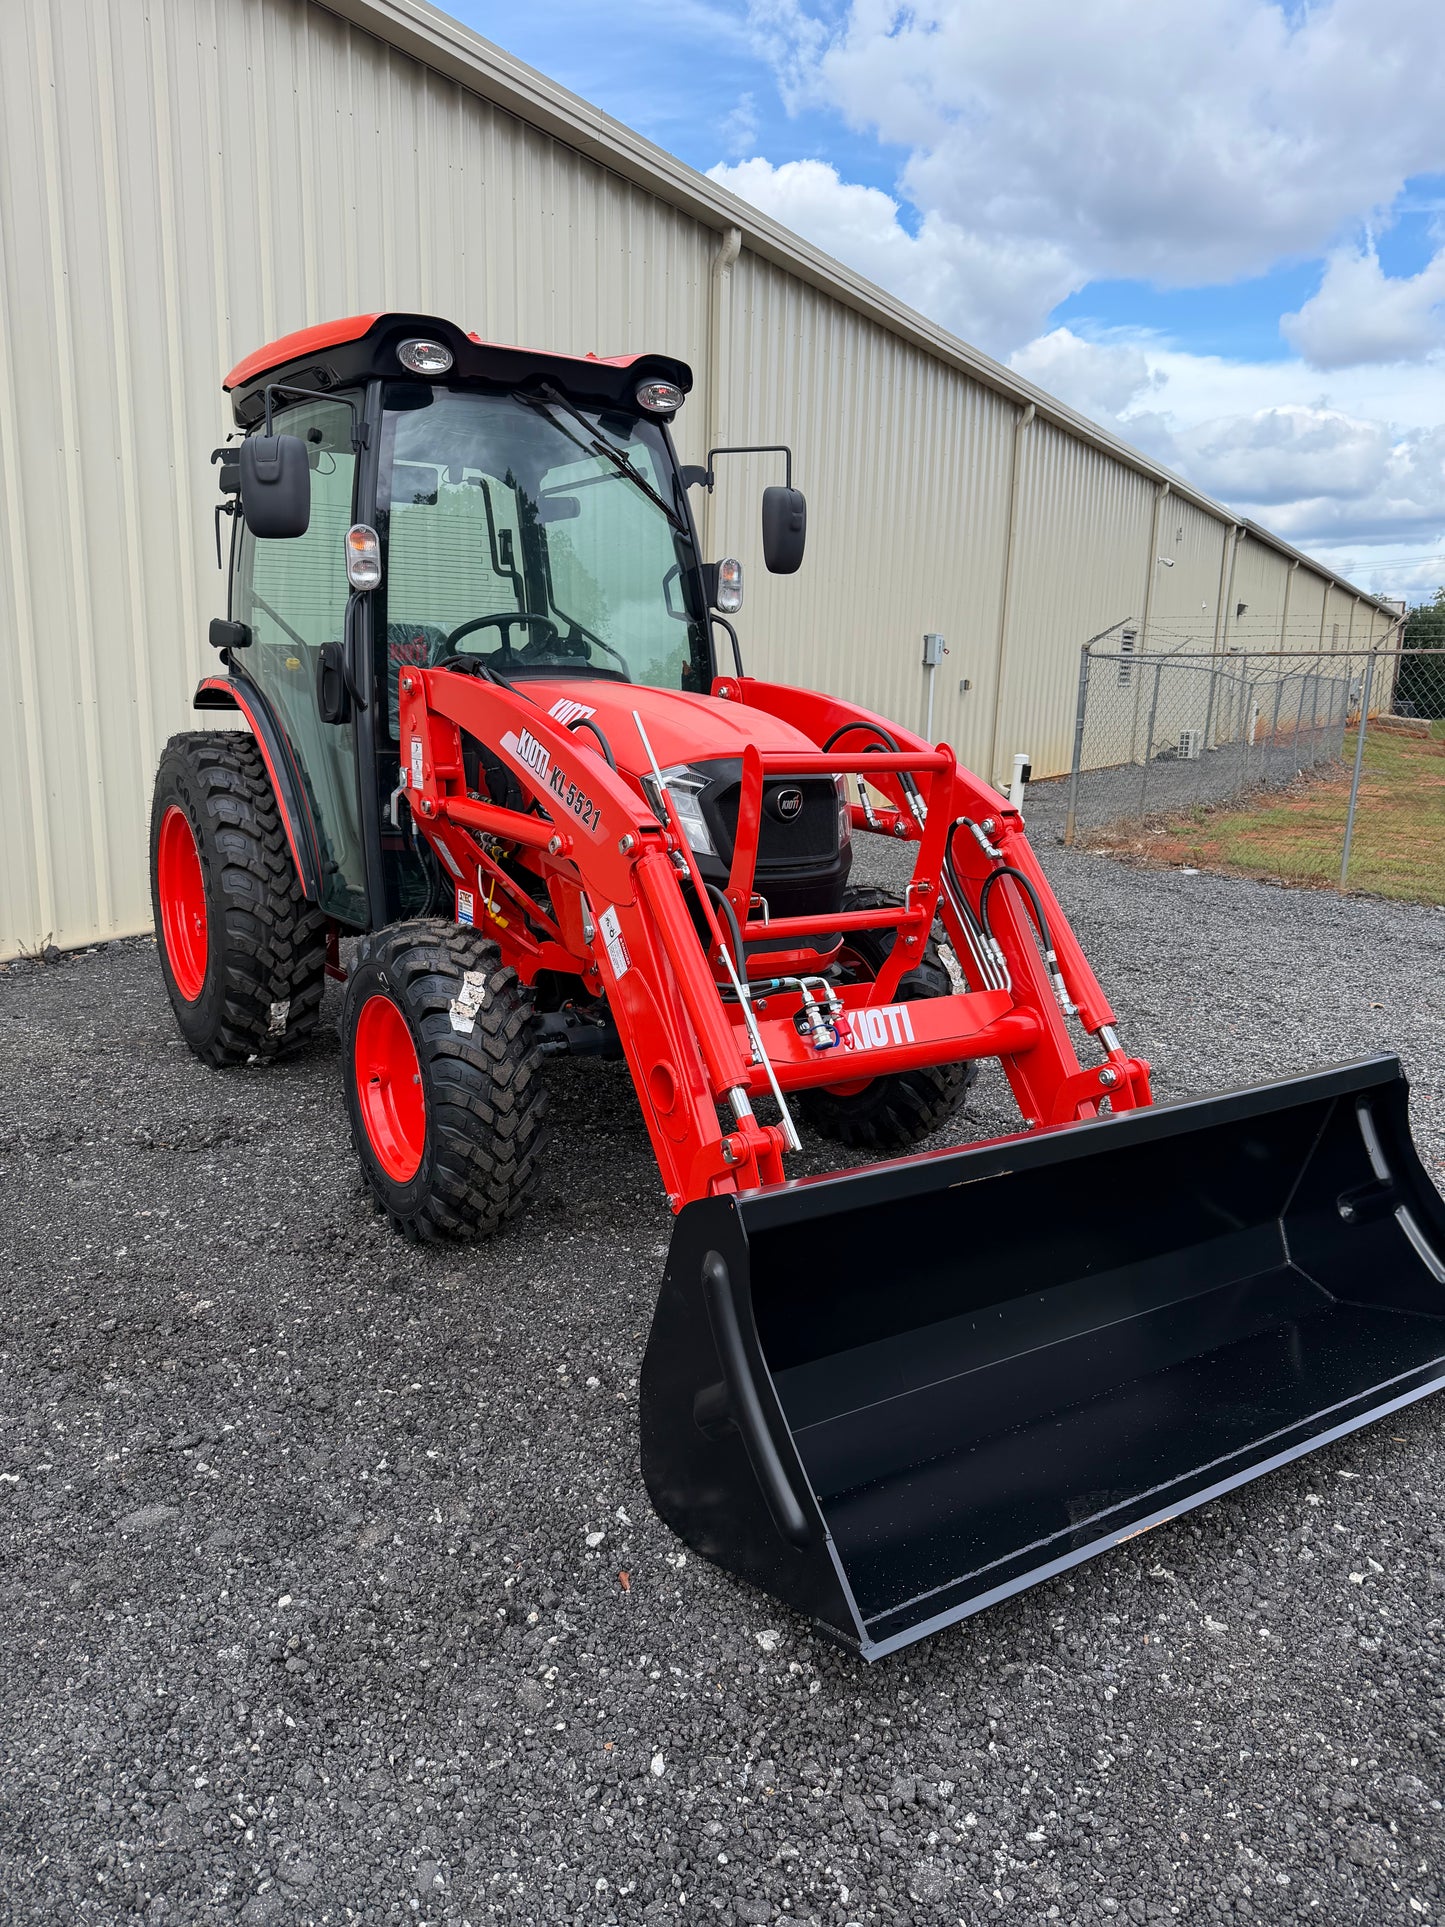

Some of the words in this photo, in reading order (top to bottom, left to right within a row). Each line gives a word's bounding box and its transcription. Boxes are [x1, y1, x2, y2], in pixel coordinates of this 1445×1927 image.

[516, 726, 551, 780] KIOTI
[781, 794, 799, 810] KIOTI
[844, 1004, 915, 1053] KIOTI
